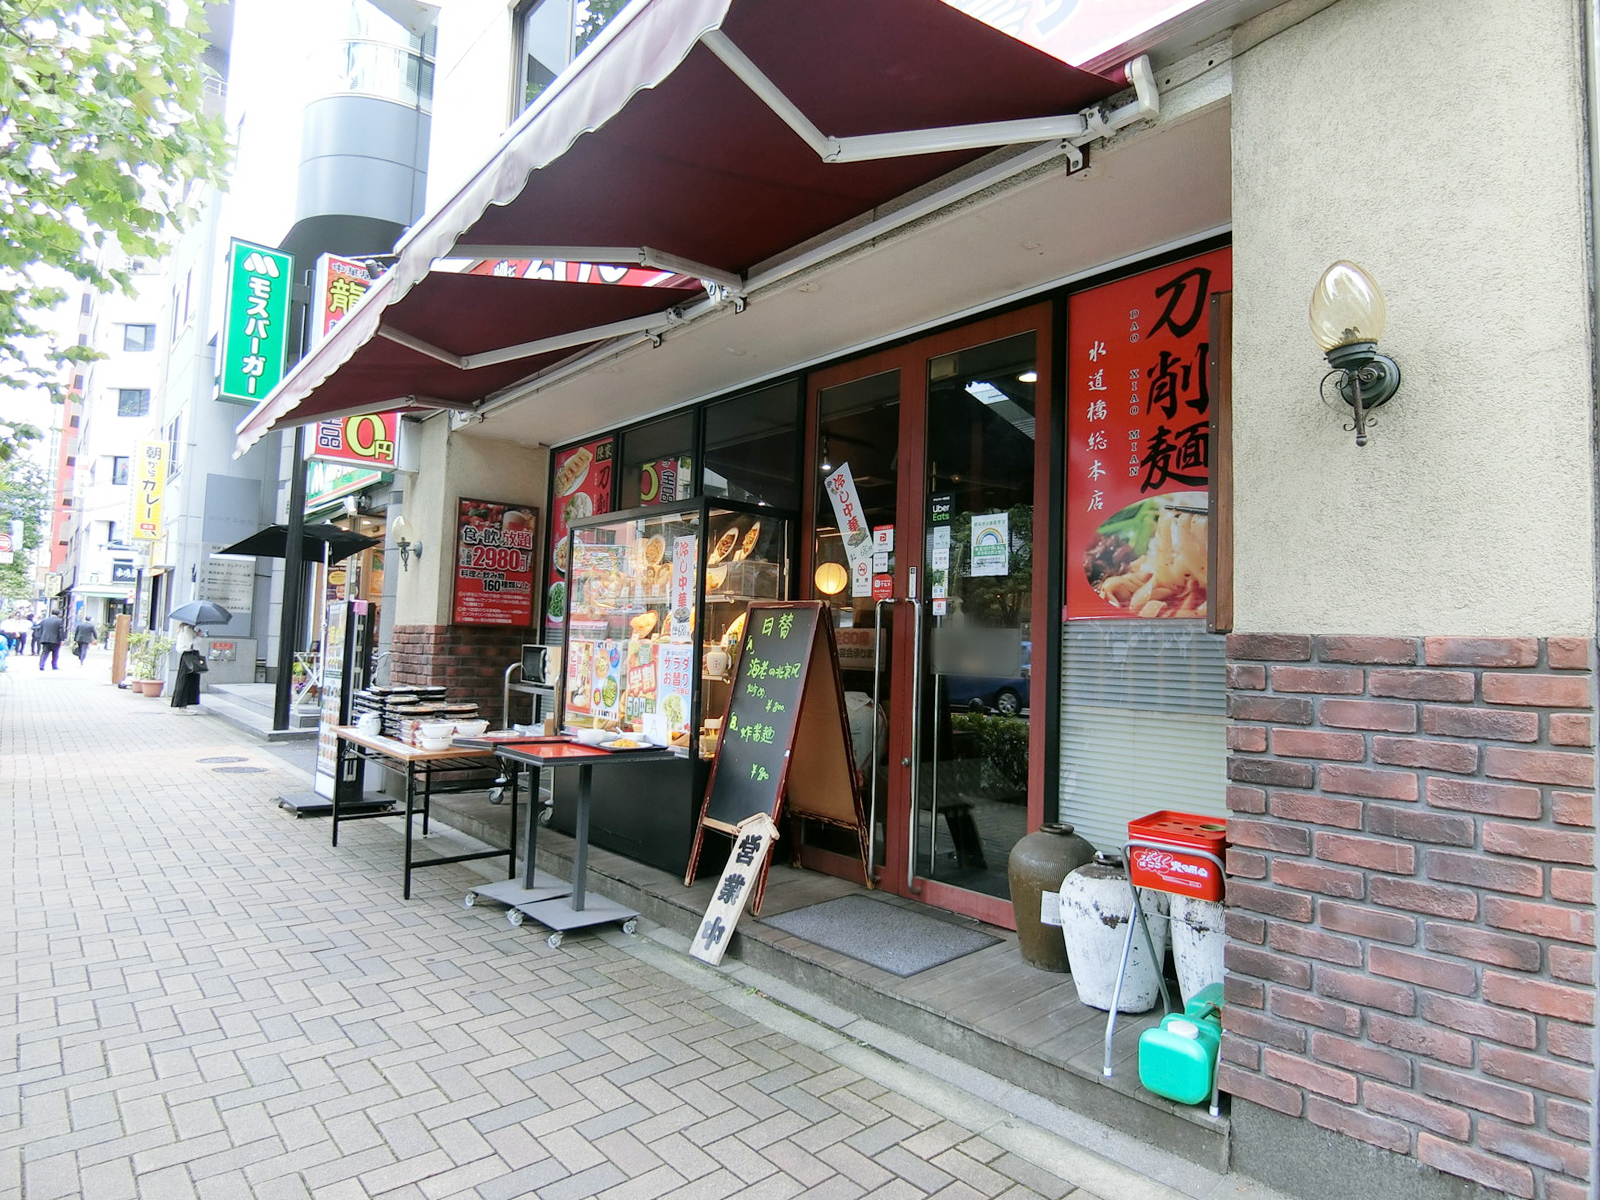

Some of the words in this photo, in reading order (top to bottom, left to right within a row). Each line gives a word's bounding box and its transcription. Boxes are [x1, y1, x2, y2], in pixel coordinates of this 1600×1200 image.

[241, 276, 272, 395] モスバーガー
[1129, 309, 1140, 343] DAO
[1129, 368, 1140, 416] XIAO
[1086, 340, 1108, 513] 水道橋総本店
[1128, 430, 1141, 477] MIAN
[142, 446, 162, 519] 朝からカレー
[833, 474, 860, 533] 冷し中華
[932, 504, 949, 512] Uber
[932, 511, 949, 520] Eats
[677, 541, 689, 608] 冷し中華
[761, 612, 794, 639] 日替
[663, 656, 690, 671] サラダ
[663, 672, 689, 687] お替り
[702, 834, 763, 951] 営業中
[1170, 860, 1209, 878] 火の用心
